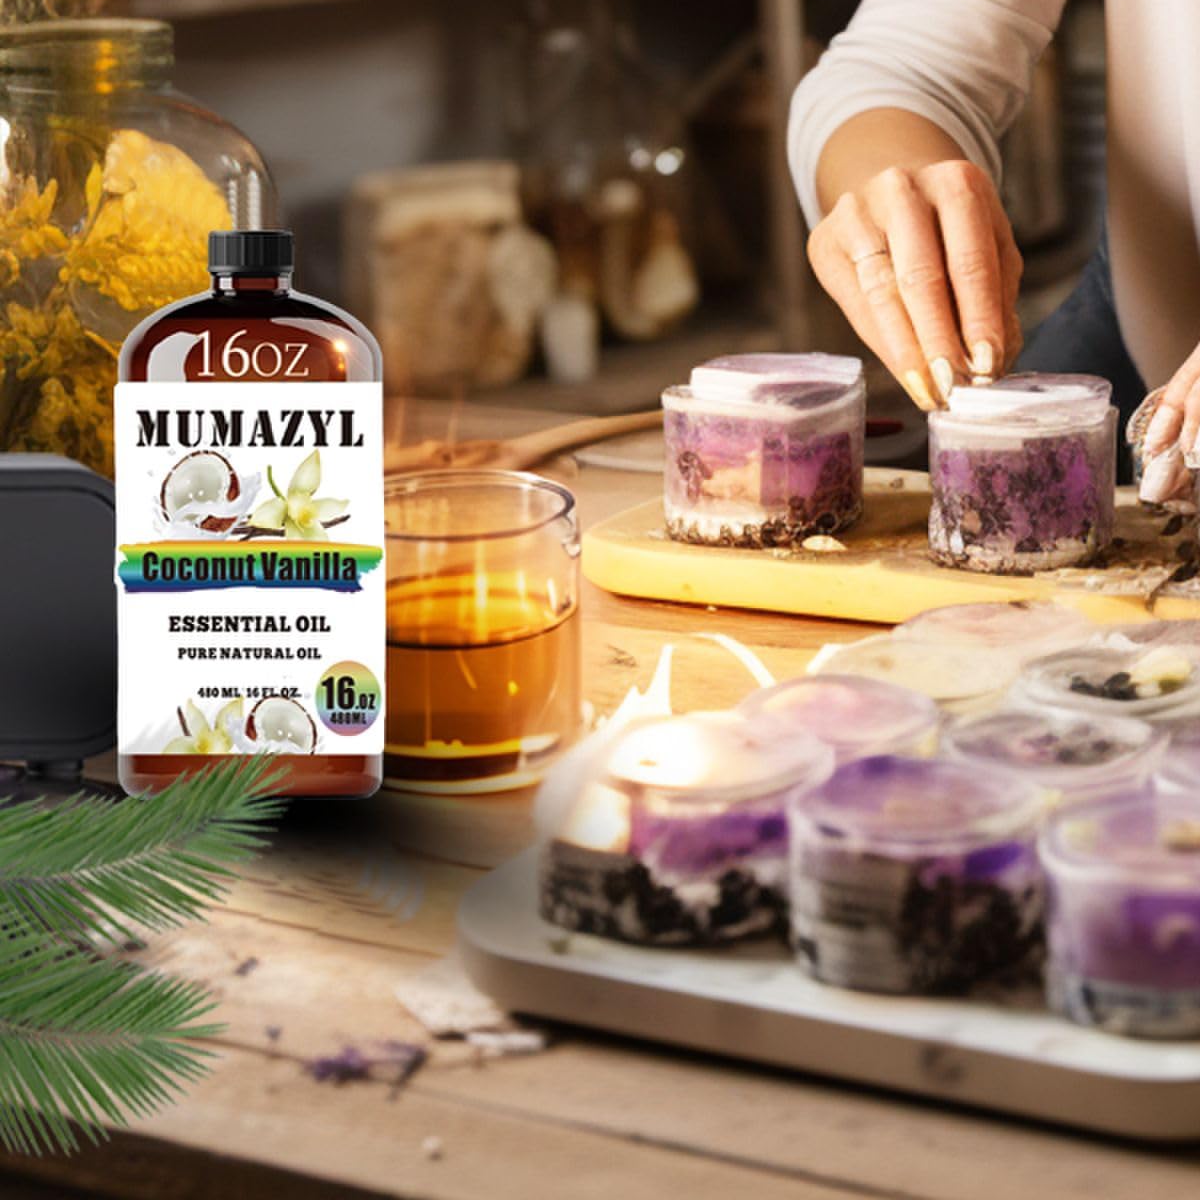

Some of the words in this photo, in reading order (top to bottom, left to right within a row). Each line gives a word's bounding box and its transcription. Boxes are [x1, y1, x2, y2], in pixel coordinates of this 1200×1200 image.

[136, 410, 364, 447] MUMAZYL
[142, 551, 256, 581] Coconut
[260, 552, 357, 581] Vanilla
[168, 615, 291, 633] ESSENTIAL
[295, 615, 331, 633] OIL
[177, 647, 217, 660] PURE
[219, 647, 294, 660] NATURAL
[296, 647, 322, 660] OIL
[221, 687, 241, 698] ML
[246, 687, 260, 698] 16
